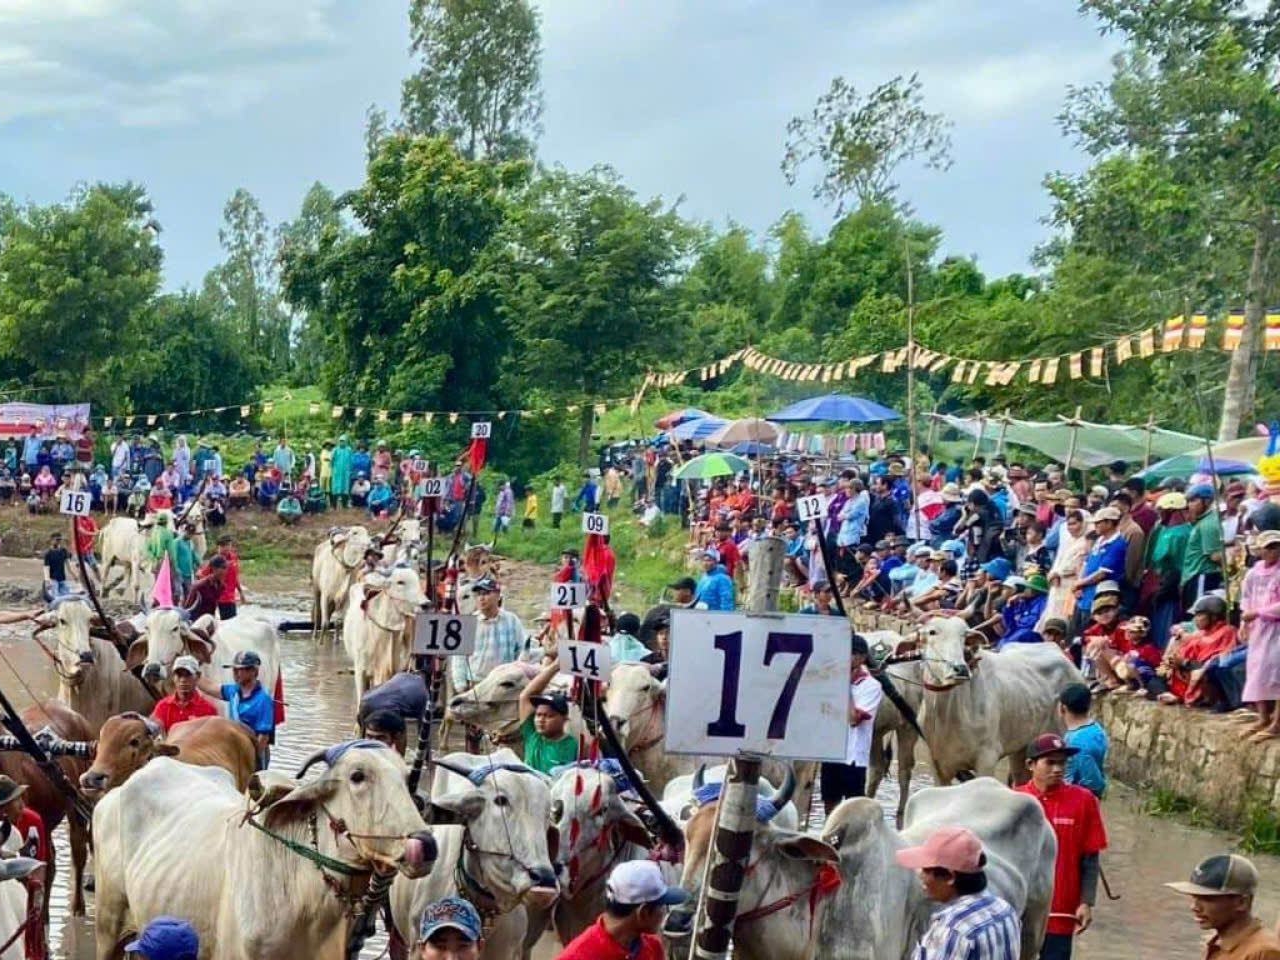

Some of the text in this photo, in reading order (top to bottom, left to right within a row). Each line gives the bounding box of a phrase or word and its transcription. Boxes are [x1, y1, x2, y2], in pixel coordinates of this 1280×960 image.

[425, 479, 441, 495] 02
[65, 493, 85, 513] 16
[804, 497, 821, 517] 12
[587, 515, 603, 532] 09
[557, 585, 578, 606] 21
[426, 619, 462, 651] 18
[568, 645, 600, 677] 14
[707, 630, 814, 740] 17
